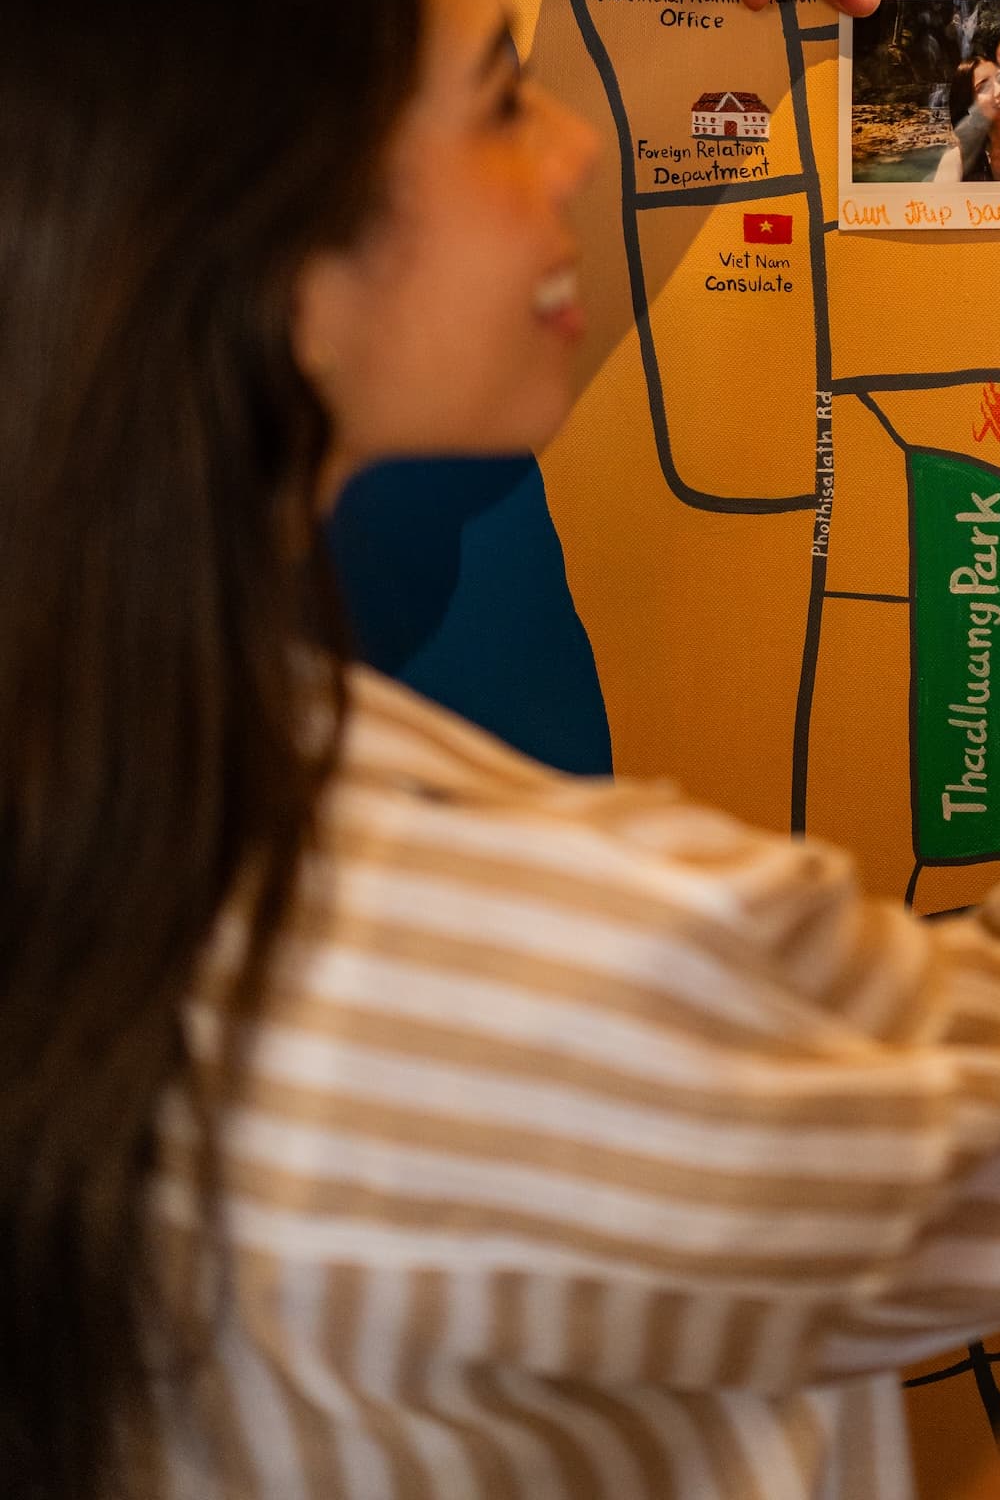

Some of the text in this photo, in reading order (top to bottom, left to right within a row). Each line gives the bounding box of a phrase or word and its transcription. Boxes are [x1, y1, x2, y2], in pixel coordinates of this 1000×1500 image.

[637, 138, 765, 164] Foreign Relation
[653, 157, 770, 188] Department
[719, 251, 791, 270] Viet Nam
[705, 274, 794, 294] Consulate
[815, 390, 834, 420] Rd
